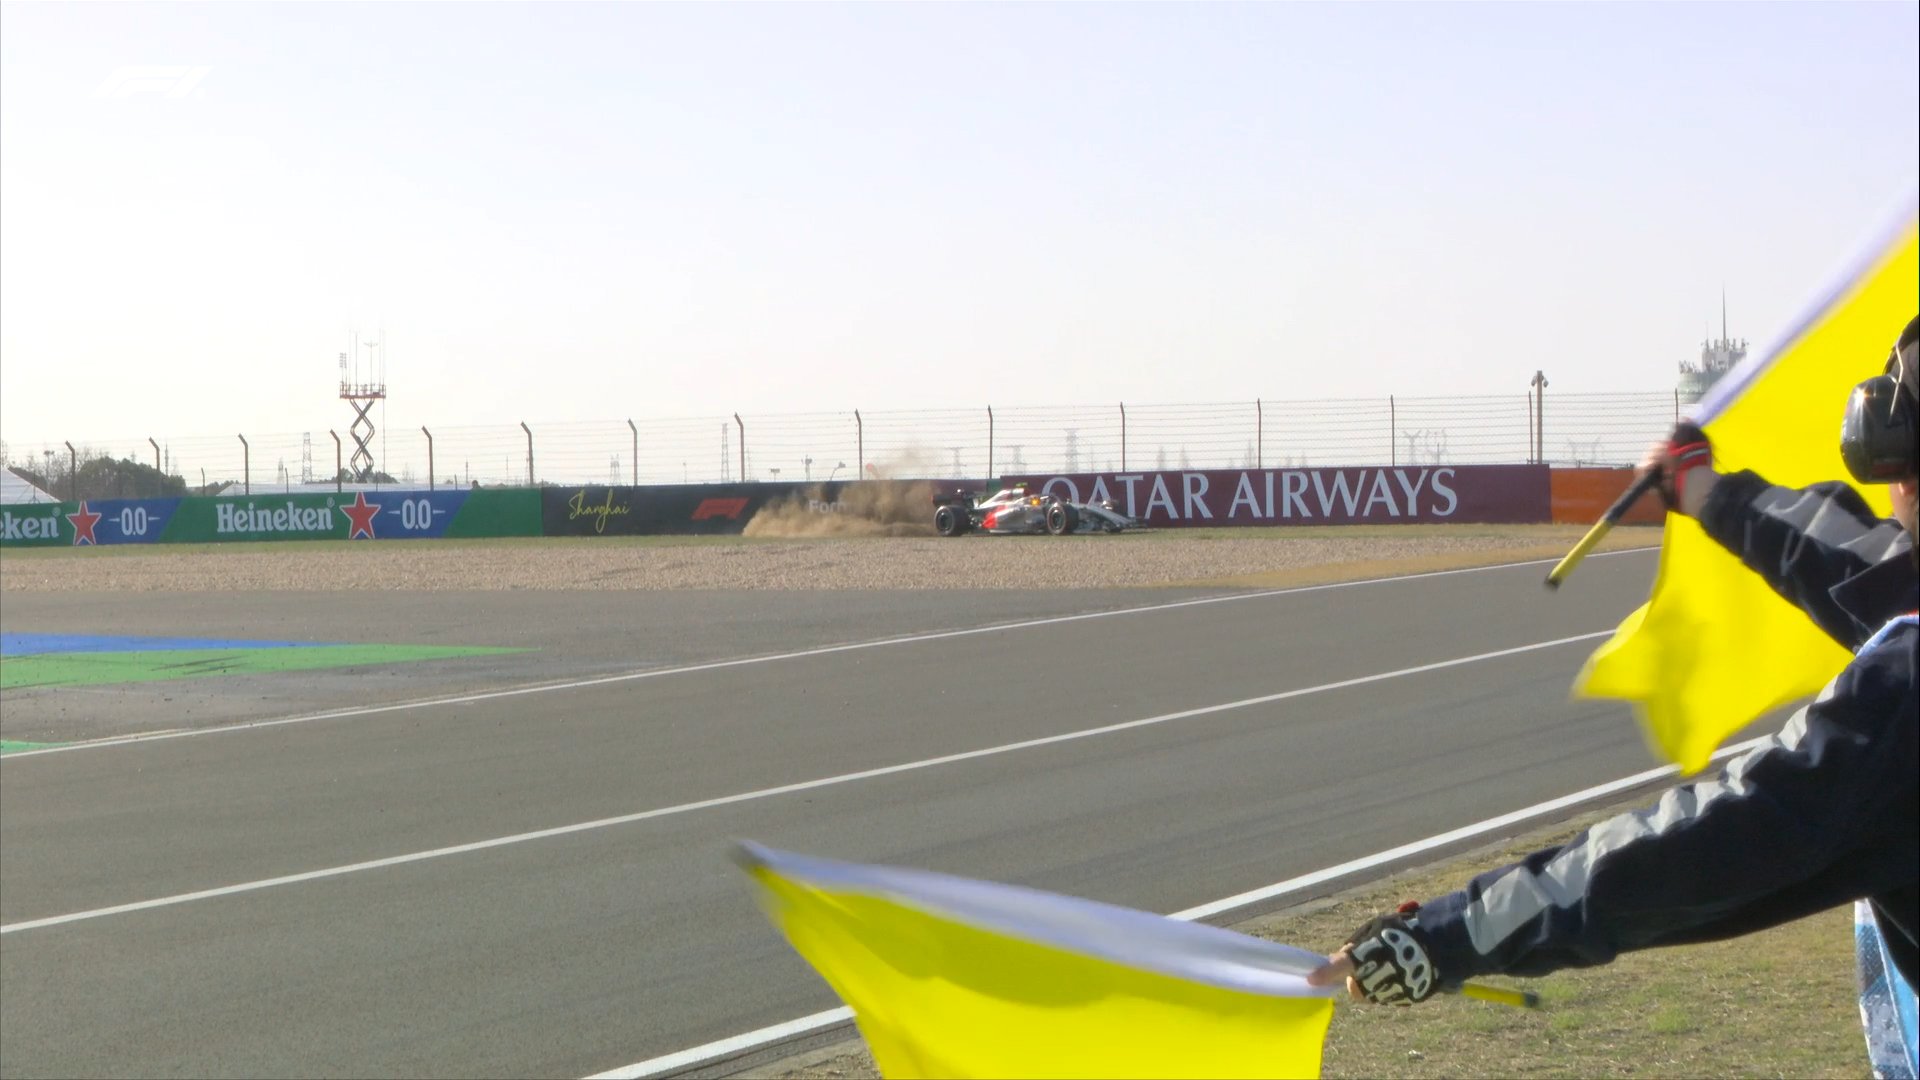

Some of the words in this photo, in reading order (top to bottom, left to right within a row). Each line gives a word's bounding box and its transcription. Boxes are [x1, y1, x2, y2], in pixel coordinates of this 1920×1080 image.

[568, 488, 630, 533] Shanghai
[1042, 471, 1214, 519] QATAR
[1228, 468, 1457, 519] AIRWAYS
[1, 511, 60, 539] ken
[216, 502, 333, 533] Heineken
